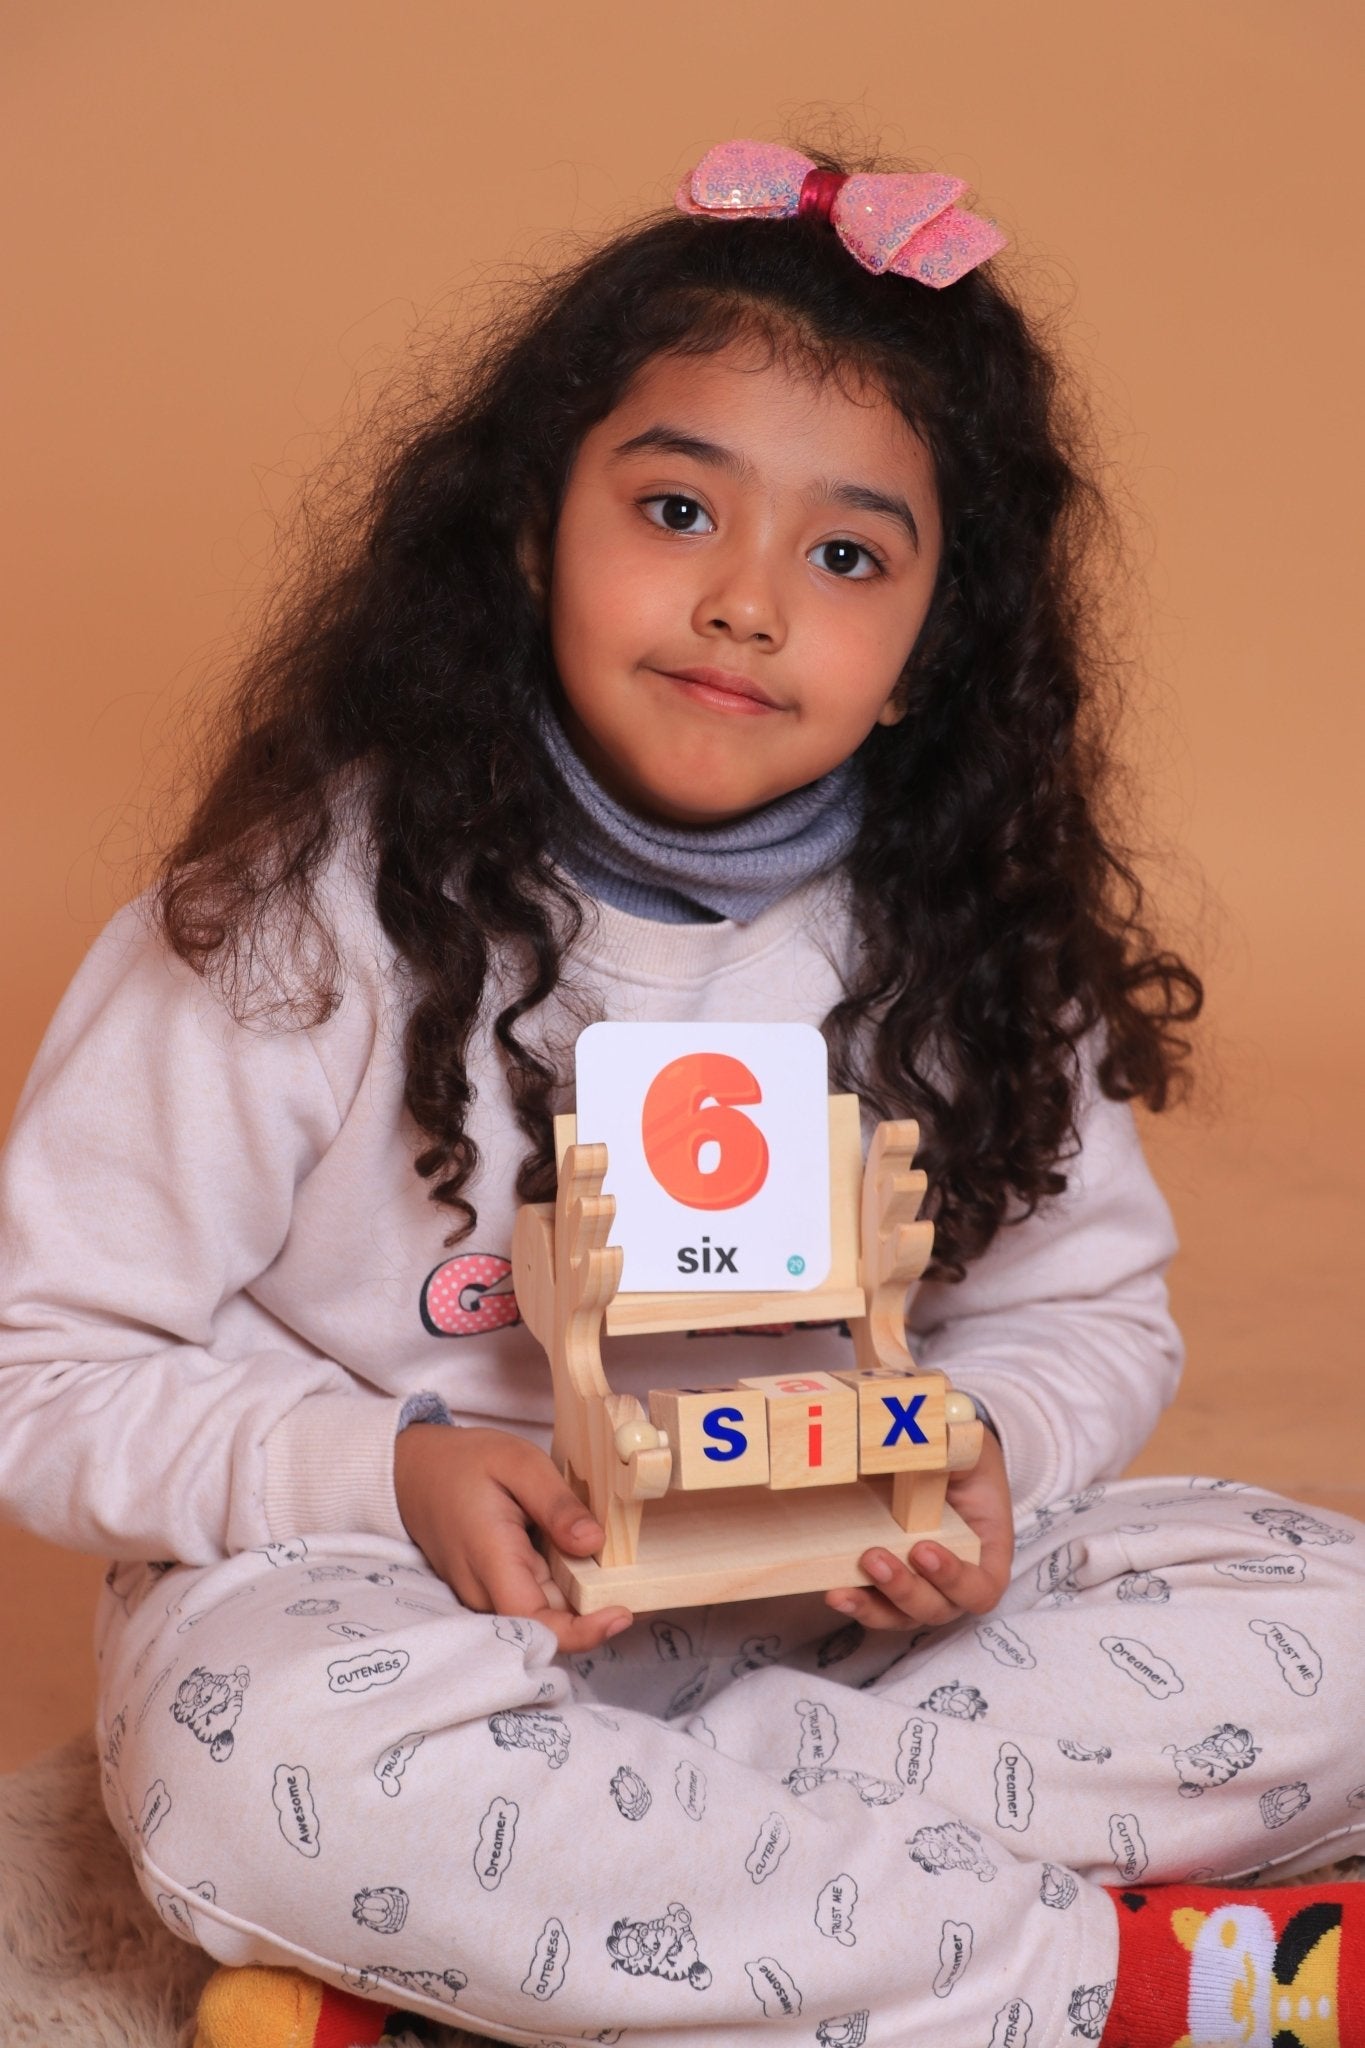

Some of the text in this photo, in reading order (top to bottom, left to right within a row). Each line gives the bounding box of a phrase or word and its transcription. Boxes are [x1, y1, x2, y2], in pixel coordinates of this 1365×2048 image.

[642, 1052, 770, 1211] 6
[677, 1236, 739, 1274] six
[337, 1659, 401, 1685] CUTENESS
[983, 1626, 1026, 1665] CUTENESS
[1112, 1642, 1167, 1686] Dreamer
[1269, 1625, 1314, 1681] TRUST ME
[809, 1707, 824, 1760] TRUST ME
[907, 1724, 923, 1785] CUTENESS
[381, 1745, 404, 1779] TRUS
[1005, 1756, 1018, 1818] Dreamer
[142, 1794, 161, 1834] eamer
[287, 1775, 312, 1845] Awesome
[484, 1811, 507, 1877] Dreamer
[755, 1820, 782, 1875] CUTENESS
[1117, 1822, 1137, 1875] CUTENESS
[832, 1886, 842, 1935] TRUST ME
[536, 1929, 559, 1994] CUTENESS
[759, 1965, 793, 2015] Awesome
[1003, 2003, 1020, 2048] TENESS
